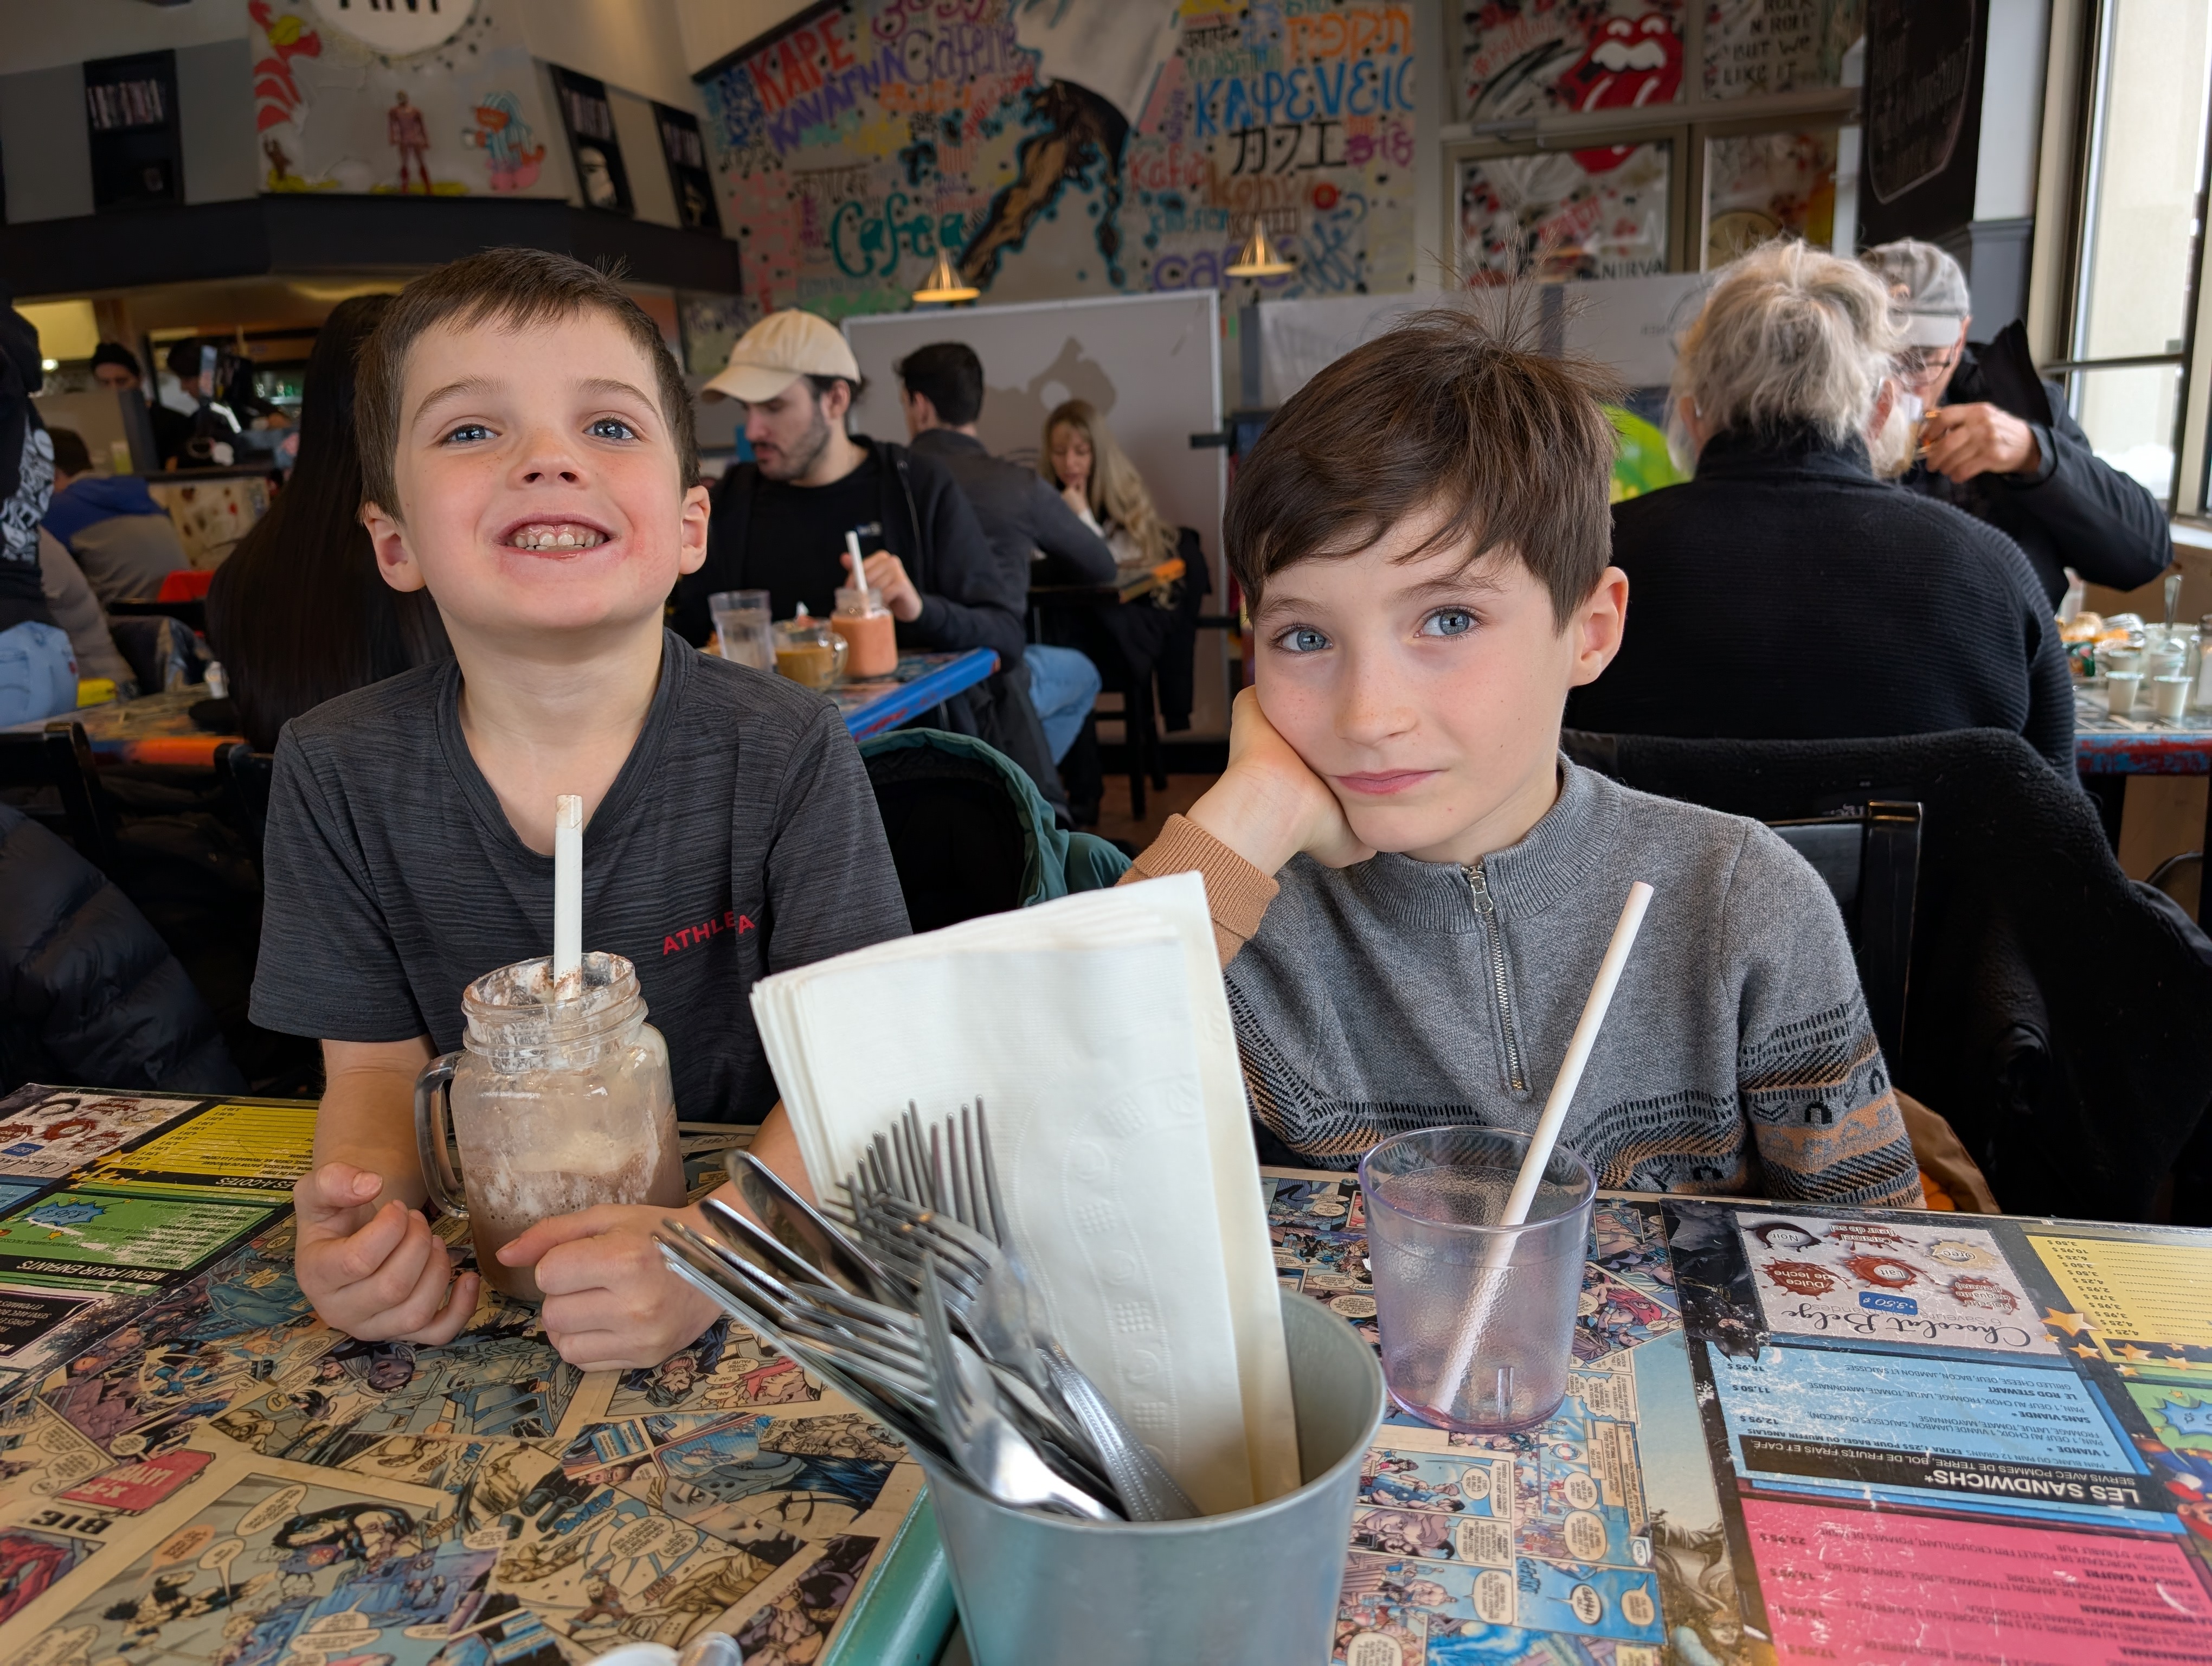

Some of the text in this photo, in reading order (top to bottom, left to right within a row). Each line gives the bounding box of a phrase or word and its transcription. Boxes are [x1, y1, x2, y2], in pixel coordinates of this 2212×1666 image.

[271, 1181, 300, 1189] ES
[1828, 1223, 1848, 1232] sel
[1848, 1226, 1866, 1234] de
[1770, 1232, 1798, 1241] Noir
[1840, 1234, 1893, 1244] Caramel
[1940, 1250, 1977, 1259] Oreo
[13, 1259, 170, 1281] MENU POUR ENFANTS
[1773, 1269, 1810, 1279] leche
[1878, 1268, 1905, 1278] Lait
[1785, 1278, 1824, 1289] Dulce
[1918, 1311, 1987, 1325] Saveurs
[1988, 1317, 2003, 1326] 6
[1781, 1303, 2031, 1347] Chocolat Belge
[1844, 1364, 1888, 1373] SAUCISSES
[1901, 1369, 1938, 1377] JAMBON
[1940, 1372, 1971, 1380] BACON,
[1809, 1382, 1864, 1392] MAYONNAISE
[2036, 1381, 2070, 1389] GRILLED
[1988, 1386, 2034, 1396] STEWART
[1935, 1393, 1978, 1402] FROMAGE,
[1983, 1397, 2010, 1406] CHOIX,
[2019, 1411, 2059, 1420] VIANDE
[2062, 1414, 2089, 1422] SANS
[1861, 1417, 1906, 1427] SAUCISSES
[1919, 1415, 1976, 1427] MAYONNAISE
[1979, 1420, 2015, 1430] TOMATE,
[1746, 1428, 1785, 1437] ANGLAIS
[1955, 1426, 1988, 1434] VIANDE
[1998, 1429, 2027, 1438] CHOIX,
[2053, 1427, 2098, 1438] FROMAGE,
[1788, 1432, 1822, 1440] MUFFIN
[2044, 1434, 2068, 1443] OEUF
[1842, 1437, 1870, 1445] BAGEL
[1873, 1440, 1899, 1449] POUR
[2080, 1437, 2102, 1445] PAIN,
[1786, 1443, 1800, 1451] ET
[1804, 1445, 1838, 1456] FRAIS
[1932, 1446, 1961, 1454] EXTRA
[2057, 1445, 2098, 1456] VIANDE
[1841, 1449, 1882, 1460] FRUITS
[1887, 1453, 1901, 1462] DE
[1966, 1449, 1997, 1458] GRAINS
[1906, 1455, 1928, 1464] BOL
[1932, 1457, 1972, 1469] TERRE,
[1979, 1463, 1995, 1471] DE
[1999, 1464, 2050, 1477] POMMES
[2055, 1470, 2087, 1481] AVEC
[2090, 1473, 2133, 1485] SERVIS
[2091, 1484, 2138, 1503] LES
